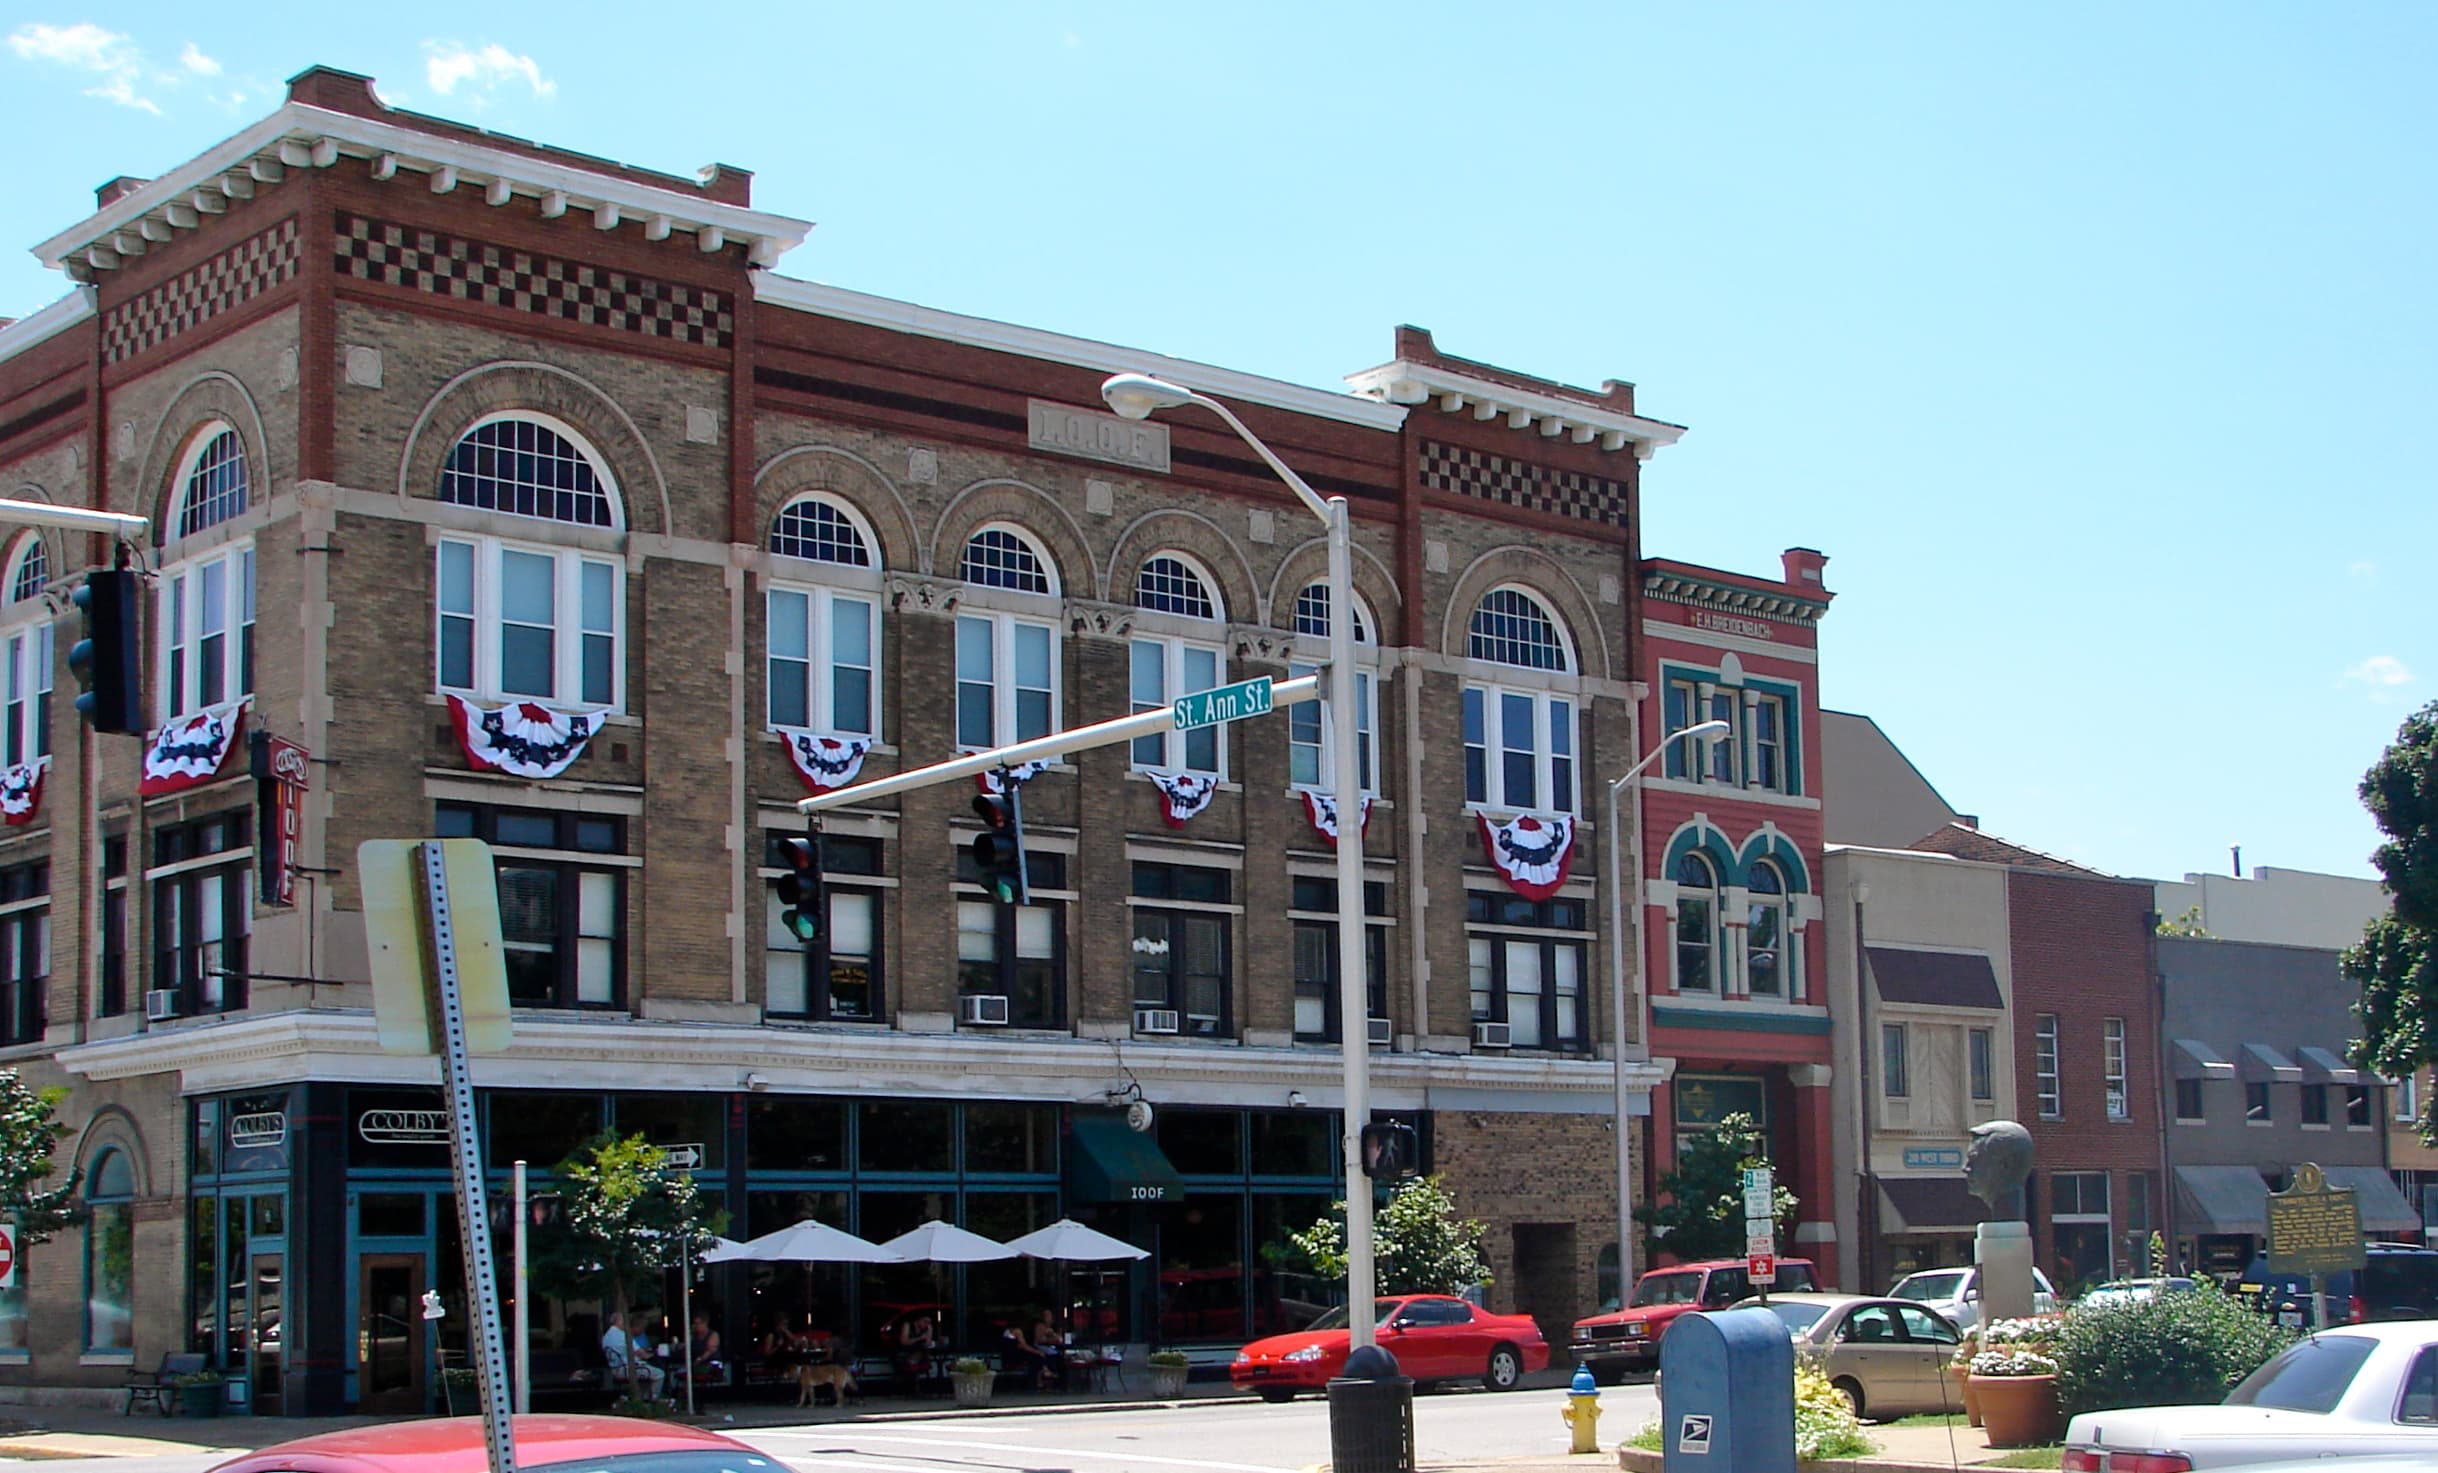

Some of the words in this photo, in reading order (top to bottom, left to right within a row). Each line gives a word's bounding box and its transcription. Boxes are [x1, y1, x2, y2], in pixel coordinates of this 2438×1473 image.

[1175, 699, 1199, 728] St.
[1204, 694, 1237, 722] Ann
[1245, 683, 1269, 713] St.
[372, 1112, 448, 1130] COLBY'
[1131, 1186, 1165, 1199] IOOF
